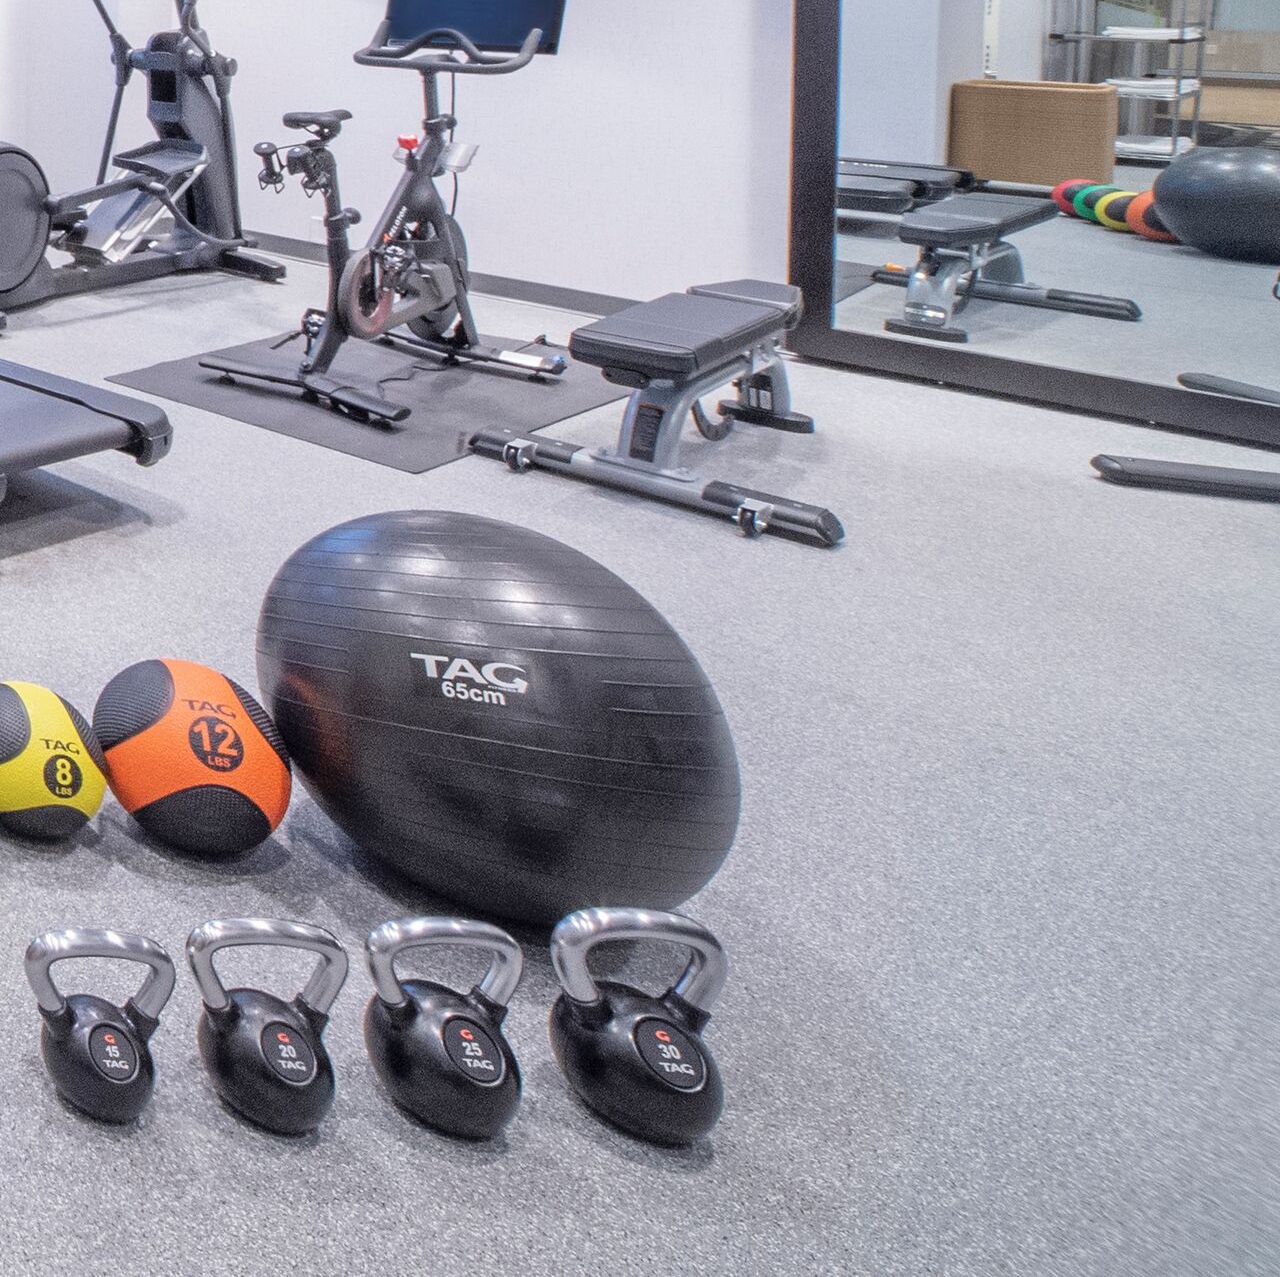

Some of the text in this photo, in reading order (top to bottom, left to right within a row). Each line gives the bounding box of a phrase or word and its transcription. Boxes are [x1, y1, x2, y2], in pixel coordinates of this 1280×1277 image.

[410, 652, 528, 694] TAG
[441, 680, 507, 706] 65cm
[181, 698, 237, 720] TAG
[193, 720, 238, 756] 12
[39, 738, 80, 755] TAG
[207, 755, 231, 768] LBS
[55, 758, 73, 786] 8
[55, 786, 72, 795] LBS
[105, 1045, 120, 1058] 15
[278, 1044, 297, 1059] 20
[461, 1042, 483, 1056] 25
[658, 1043, 681, 1060] 30
[102, 1059, 129, 1070] TAG
[277, 1059, 307, 1072] TAG
[461, 1058, 495, 1071] TAG
[658, 1062, 695, 1076] TAG
